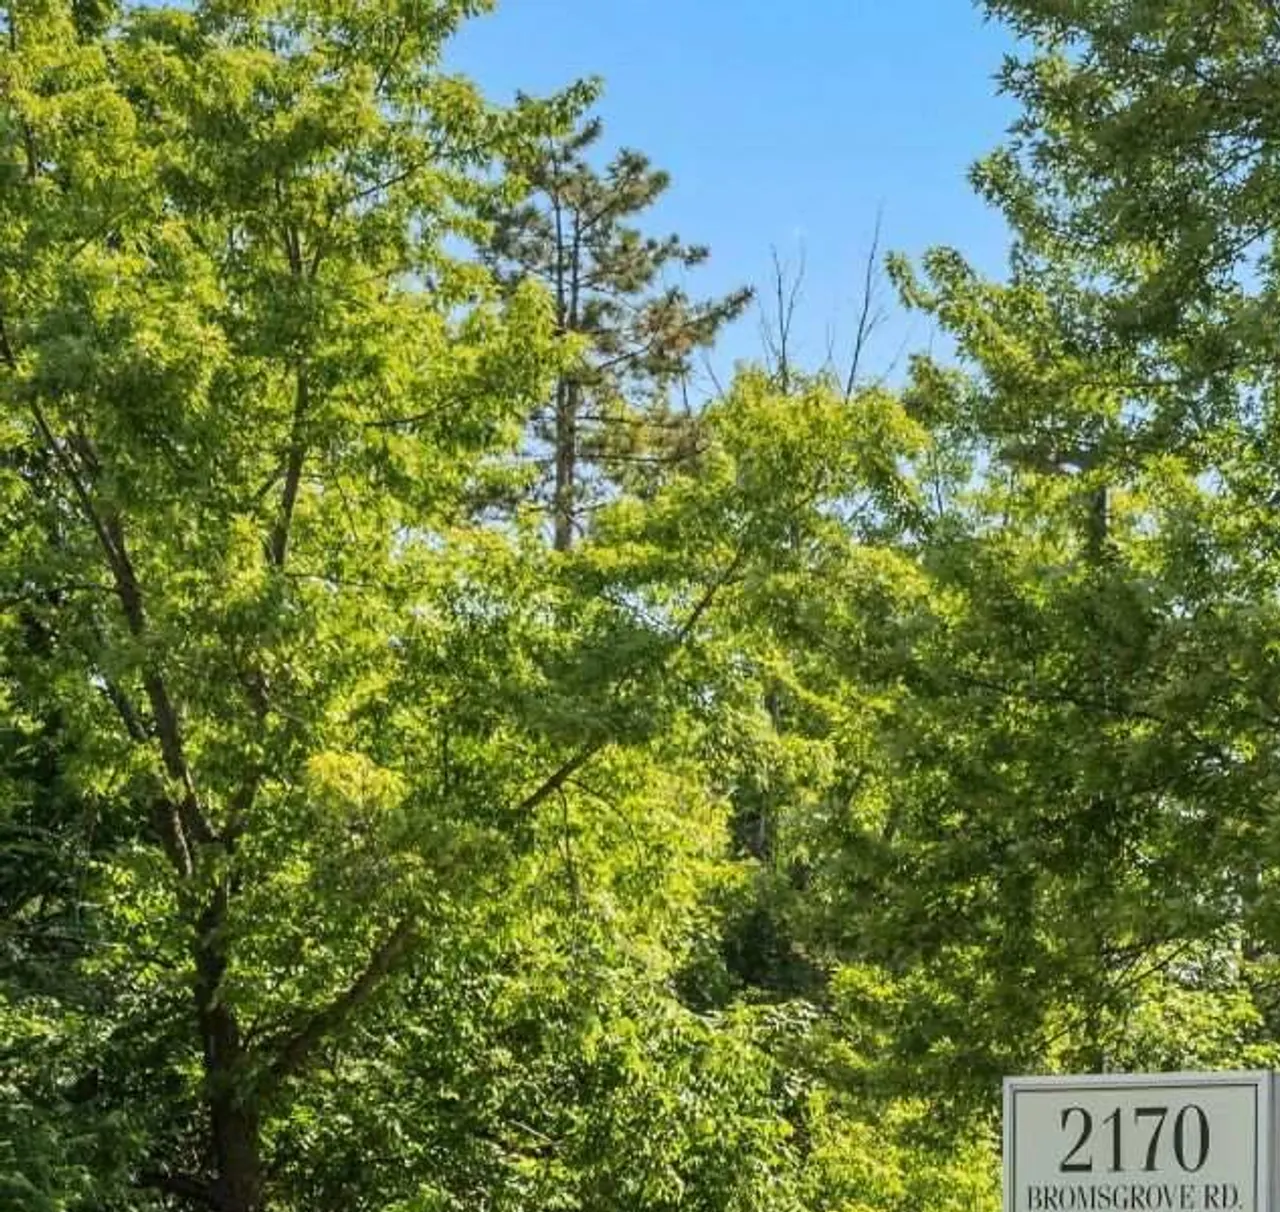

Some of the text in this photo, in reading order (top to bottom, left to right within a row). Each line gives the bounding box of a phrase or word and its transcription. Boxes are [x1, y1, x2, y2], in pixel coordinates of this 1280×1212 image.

[1059, 1104, 1210, 1173] 2170
[1028, 1184, 1243, 1210] BROMSGROVE RD.
